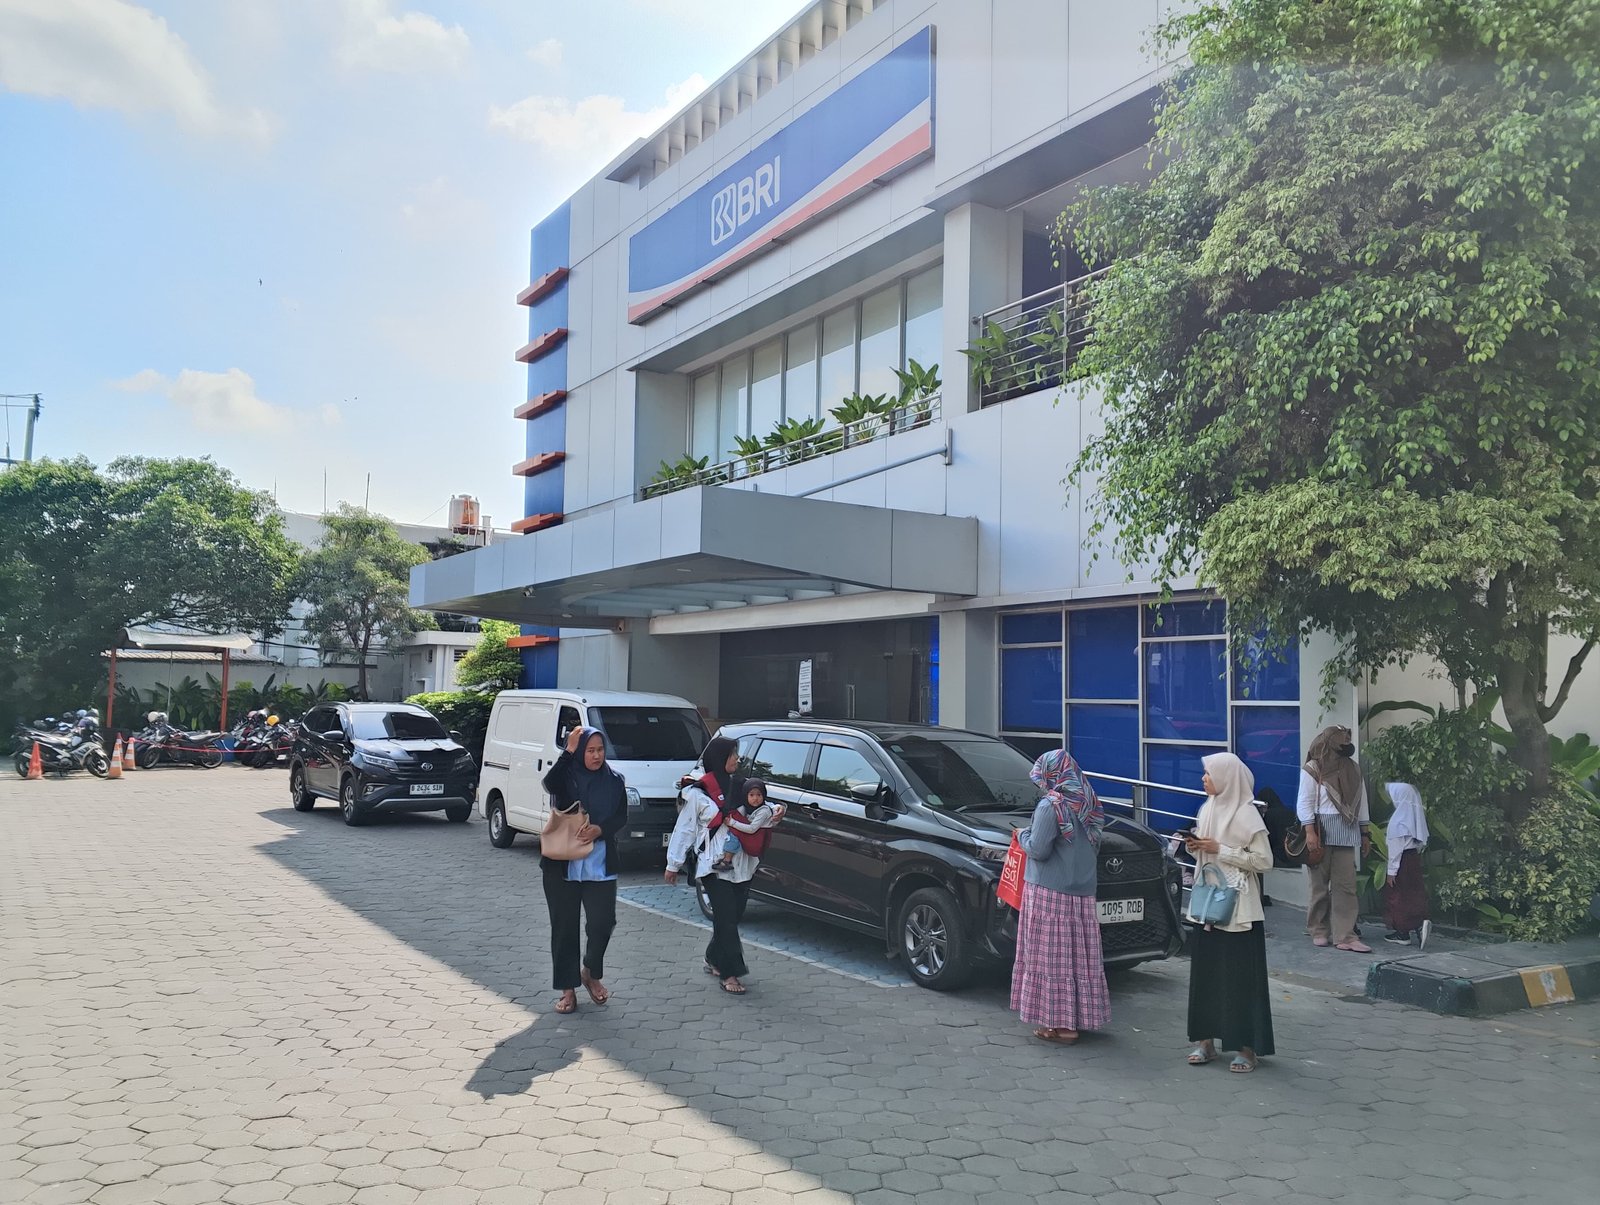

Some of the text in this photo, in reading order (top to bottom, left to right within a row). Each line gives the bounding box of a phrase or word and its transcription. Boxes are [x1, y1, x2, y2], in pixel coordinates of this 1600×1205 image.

[737, 154, 781, 227] BRI
[1102, 900, 1143, 916] 1095 ROB
